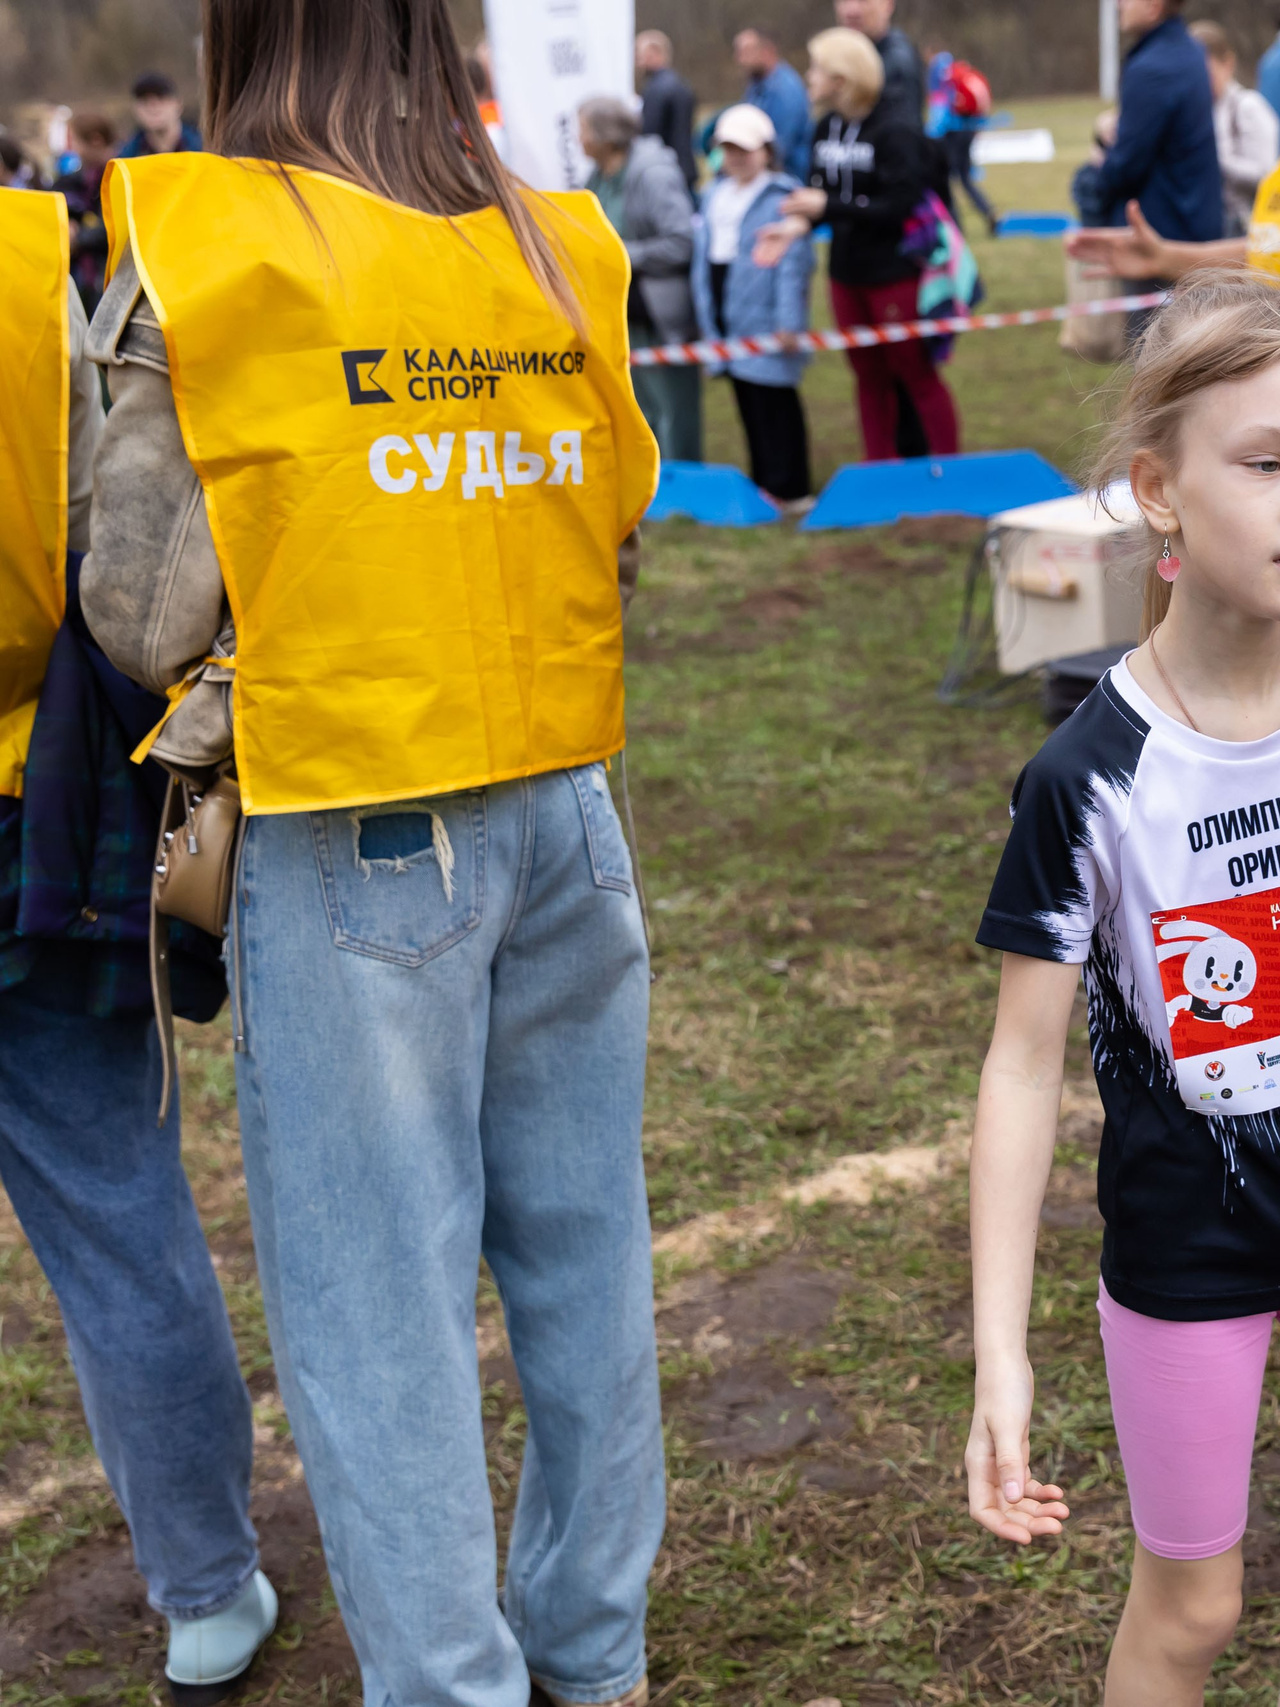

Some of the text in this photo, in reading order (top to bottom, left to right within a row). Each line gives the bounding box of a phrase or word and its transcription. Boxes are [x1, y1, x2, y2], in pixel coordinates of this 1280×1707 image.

[403, 348, 585, 375] КАЛАШНИКОВ
[407, 375, 501, 401] СПОРТ
[368, 430, 584, 500] СУДЬЯ
